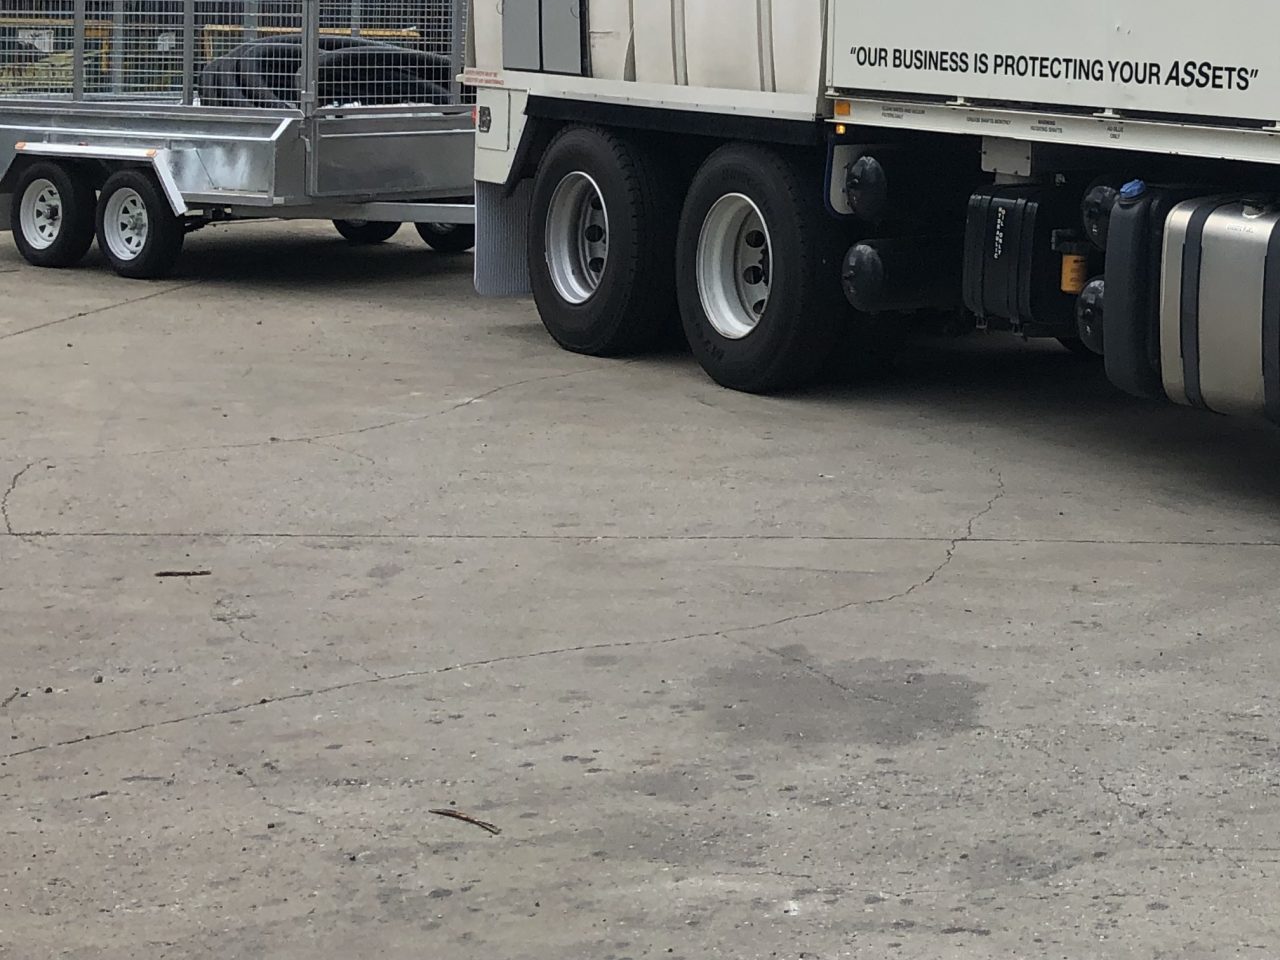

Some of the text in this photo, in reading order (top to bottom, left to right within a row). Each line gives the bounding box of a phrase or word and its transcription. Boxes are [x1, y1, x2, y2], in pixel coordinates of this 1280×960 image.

[892, 48, 969, 73] BUSINESS
[974, 53, 988, 74] IS
[993, 54, 1104, 82] PROTECTING
[1107, 60, 1161, 85] YOUR
